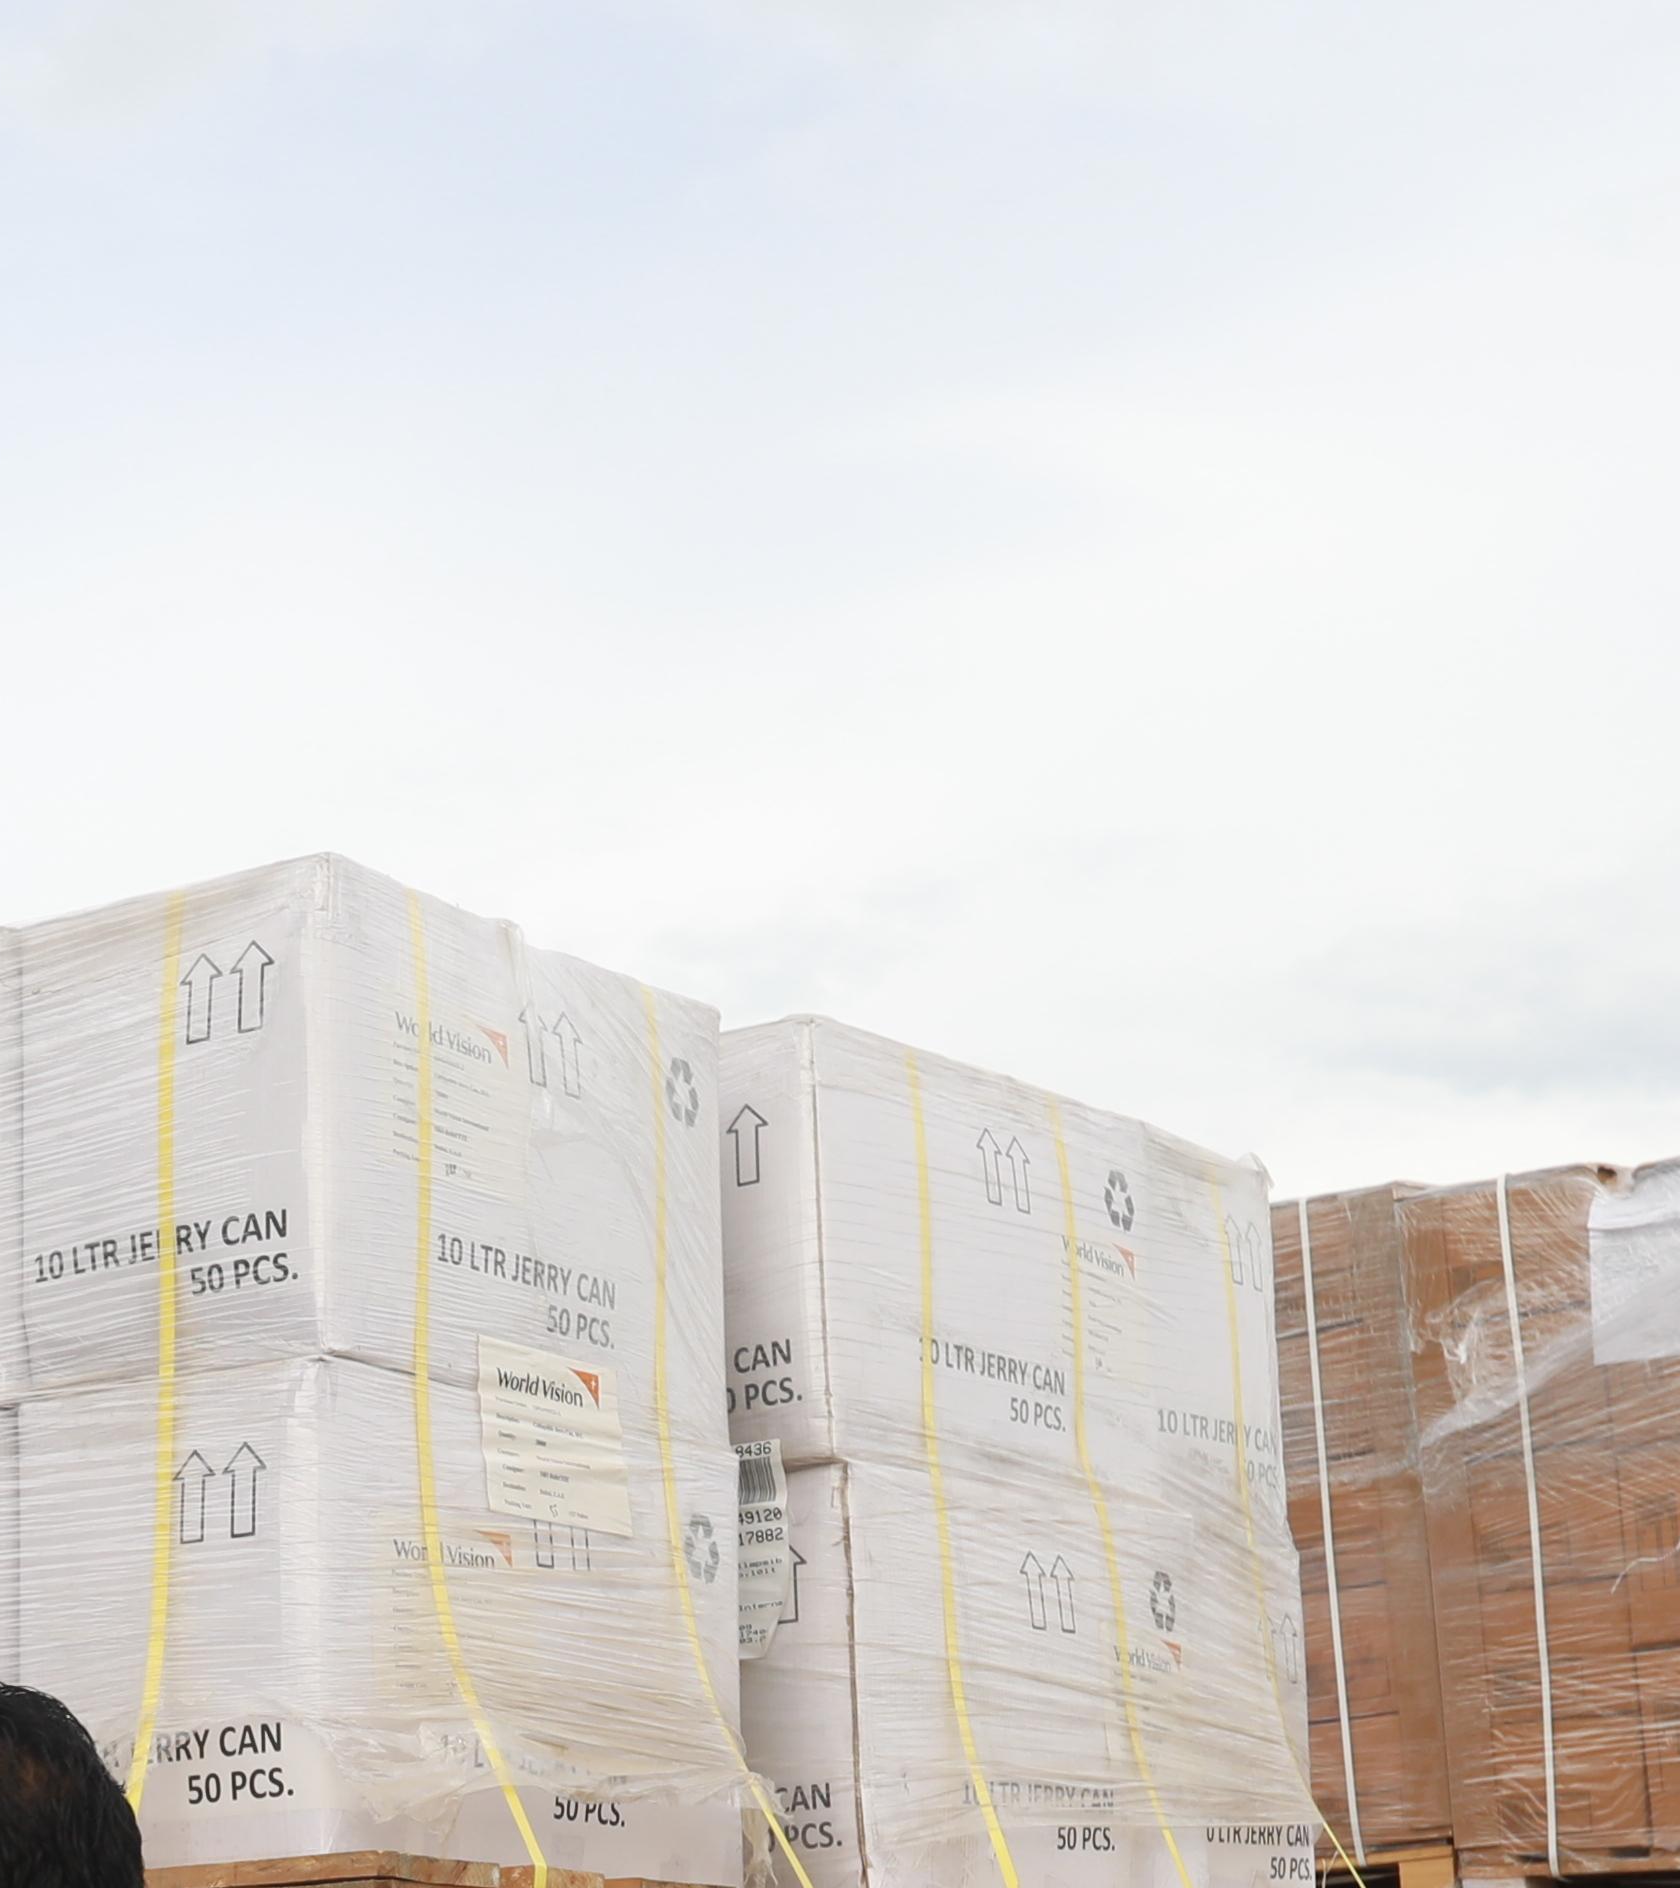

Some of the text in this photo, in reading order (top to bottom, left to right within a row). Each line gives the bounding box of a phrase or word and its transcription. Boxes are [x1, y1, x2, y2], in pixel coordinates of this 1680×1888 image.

[34, 1251, 65, 1284] 10
[72, 1238, 121, 1276] LTR
[221, 1209, 288, 1246] CAN
[190, 1251, 299, 1296] 50 PCS.
[436, 1233, 617, 1310] 10 LTR JERRY CAN
[546, 1304, 616, 1350] 50 PCS.
[732, 1338, 794, 1375] CAN
[944, 1341, 976, 1375] LTR
[980, 1349, 1028, 1385] JERRY
[1032, 1364, 1067, 1398] CAN
[496, 1366, 584, 1408] World Vision
[743, 1378, 803, 1412] PCS.
[1009, 1397, 1067, 1434] 50 PCS.
[186, 1767, 295, 1805] 50 PCS.
[553, 1796, 626, 1828] 50 PCS.
[1056, 1826, 1116, 1852] 50 PCS.
[1269, 1856, 1313, 1882] 50 PCS.
